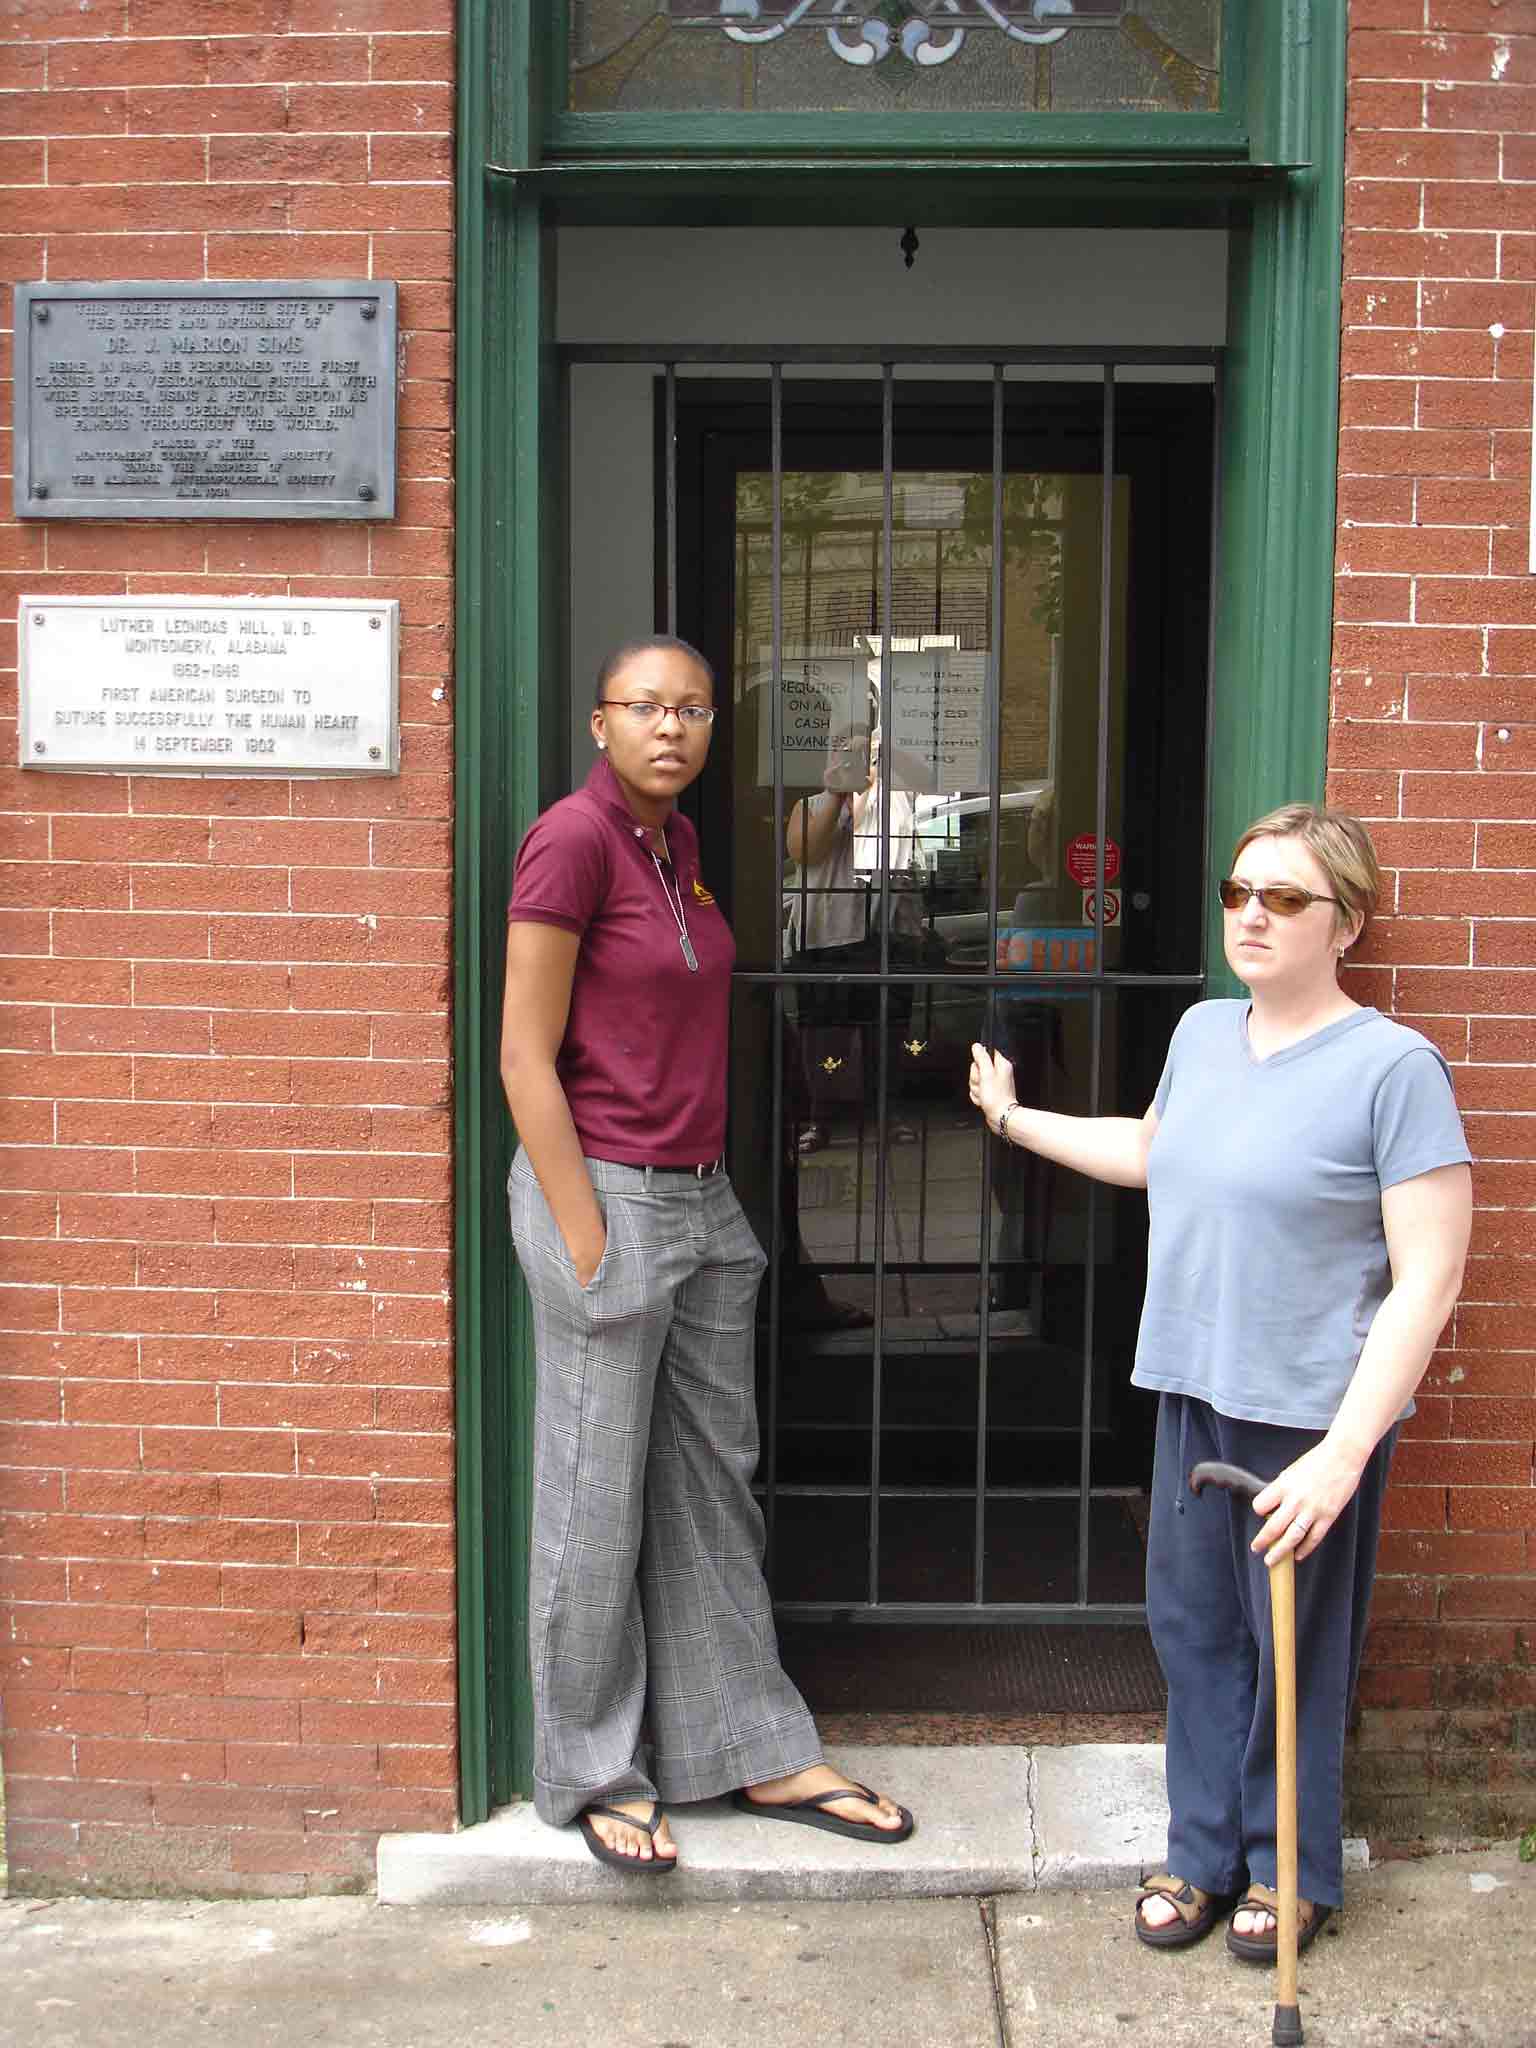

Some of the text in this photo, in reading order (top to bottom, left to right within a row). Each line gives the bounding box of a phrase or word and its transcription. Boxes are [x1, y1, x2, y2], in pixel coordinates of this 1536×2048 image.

[104, 336, 304, 354] DR. J. MARION SIMS
[35, 375, 377, 389] CLOSURE OF A VESICO-VAGINAL FISTULA WITH
[140, 404, 174, 418] THIS
[183, 404, 265, 418] OPERATION
[274, 404, 318, 418] MADE
[327, 404, 356, 418] HIM
[71, 418, 129, 432] FAMOUS
[140, 418, 235, 432] THROUGHOUT
[246, 418, 276, 432] THE
[100, 617, 154, 633] LUTHER
[164, 618, 229, 635] LEONIDAS
[226, 639, 288, 656] ALABAMA
[101, 687, 313, 704] FIRST AMERICAN SURGEON TO
[55, 710, 359, 730] SUTURE SUCCESSFULLY THE HUMAN HEART
[794, 718, 831, 729] CASH
[155, 736, 233, 752] SEPTEMBER
